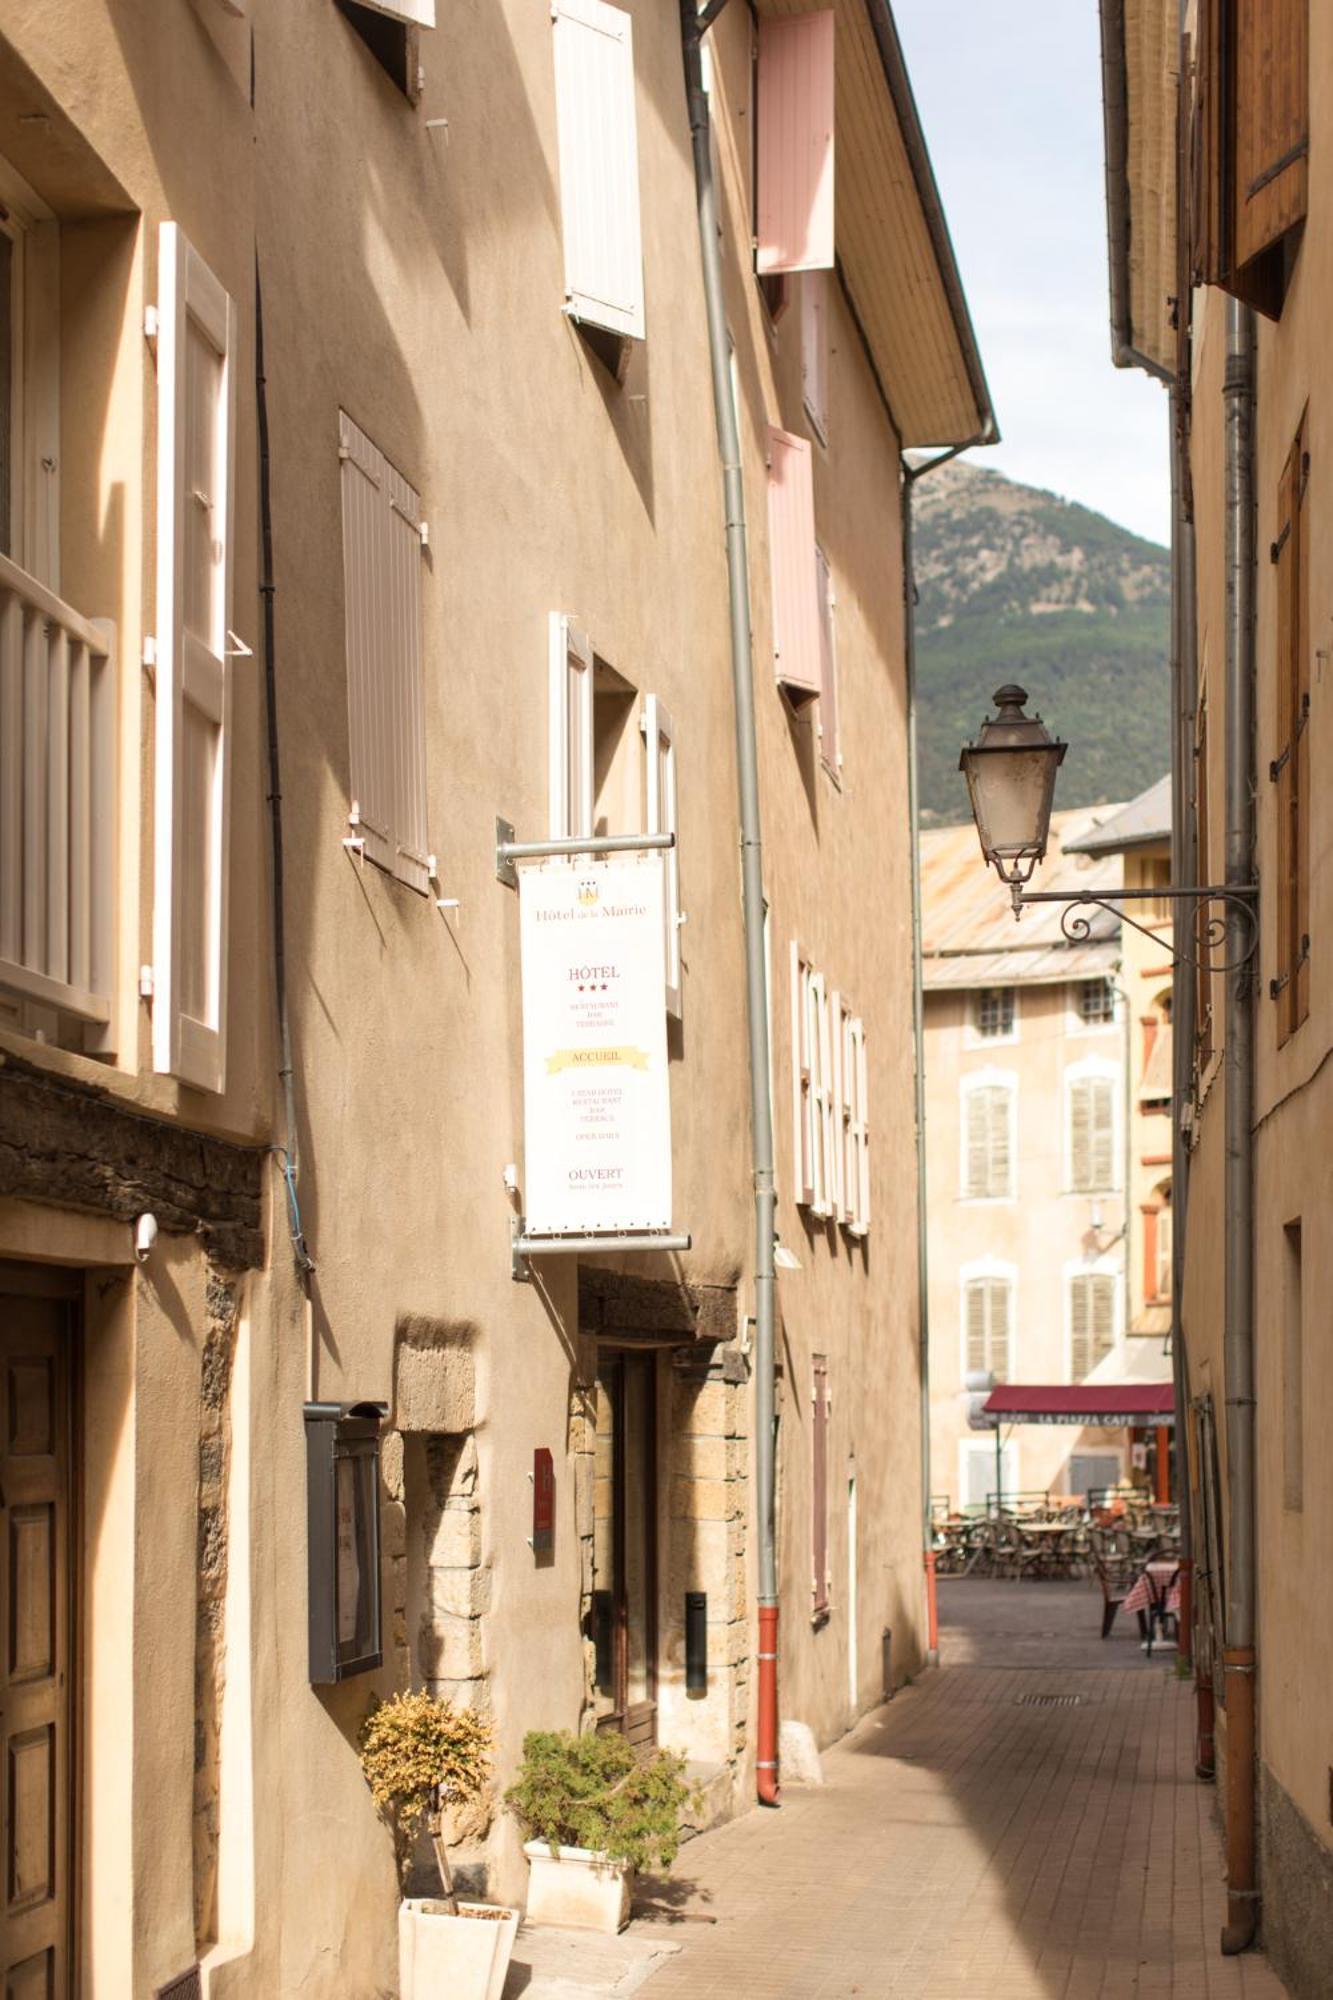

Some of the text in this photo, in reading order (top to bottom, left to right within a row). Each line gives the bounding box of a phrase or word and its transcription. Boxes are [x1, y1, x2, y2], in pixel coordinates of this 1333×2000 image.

[536, 908, 574, 922] Hôtel
[602, 904, 646, 918] Mairie
[568, 965, 620, 981] HÔTEL
[572, 1050, 621, 1063] ACCUEIL
[569, 1167, 624, 1181] OUVERT
[1056, 1414, 1099, 1425] PIAZZA
